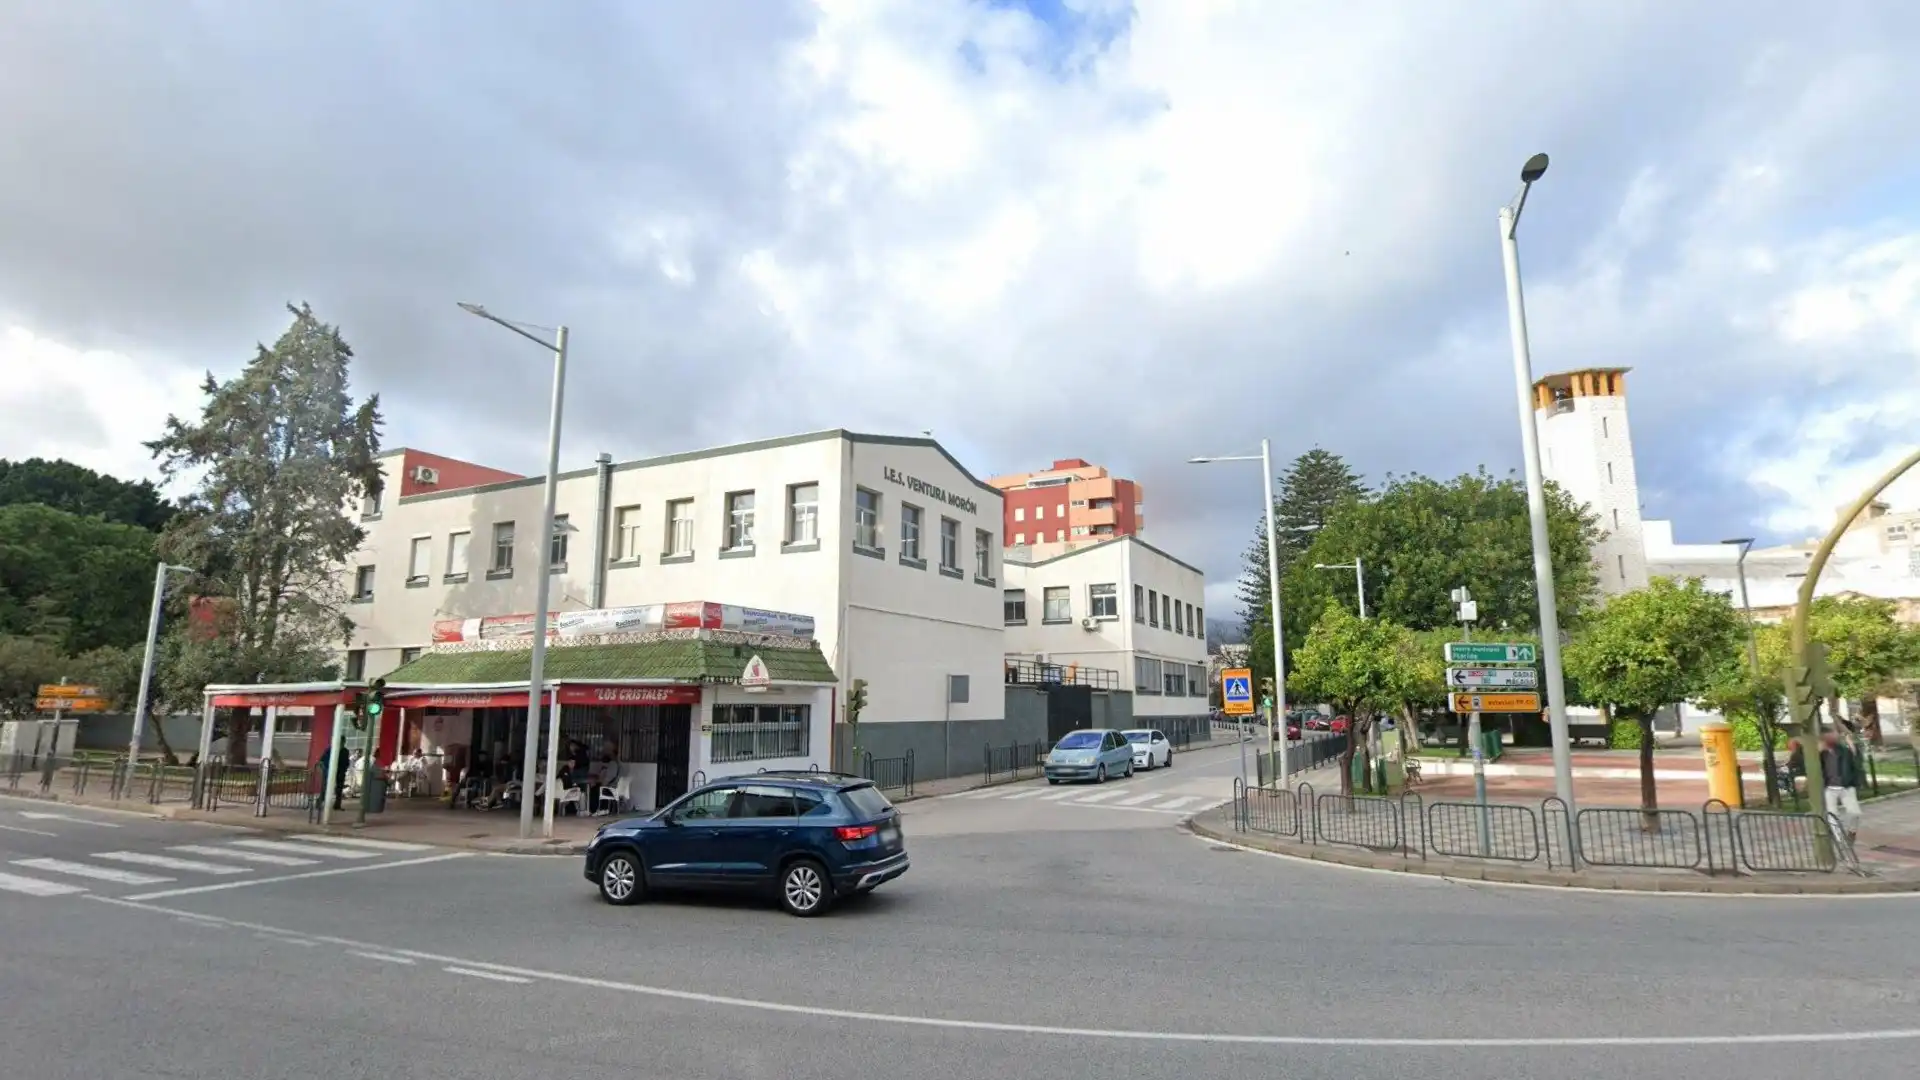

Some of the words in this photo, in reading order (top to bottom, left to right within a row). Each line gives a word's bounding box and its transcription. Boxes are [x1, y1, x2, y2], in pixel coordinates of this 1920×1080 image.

[884, 466, 905, 486] I.E.S.
[907, 476, 946, 503] VENTURA
[948, 491, 977, 515] MORÓN
